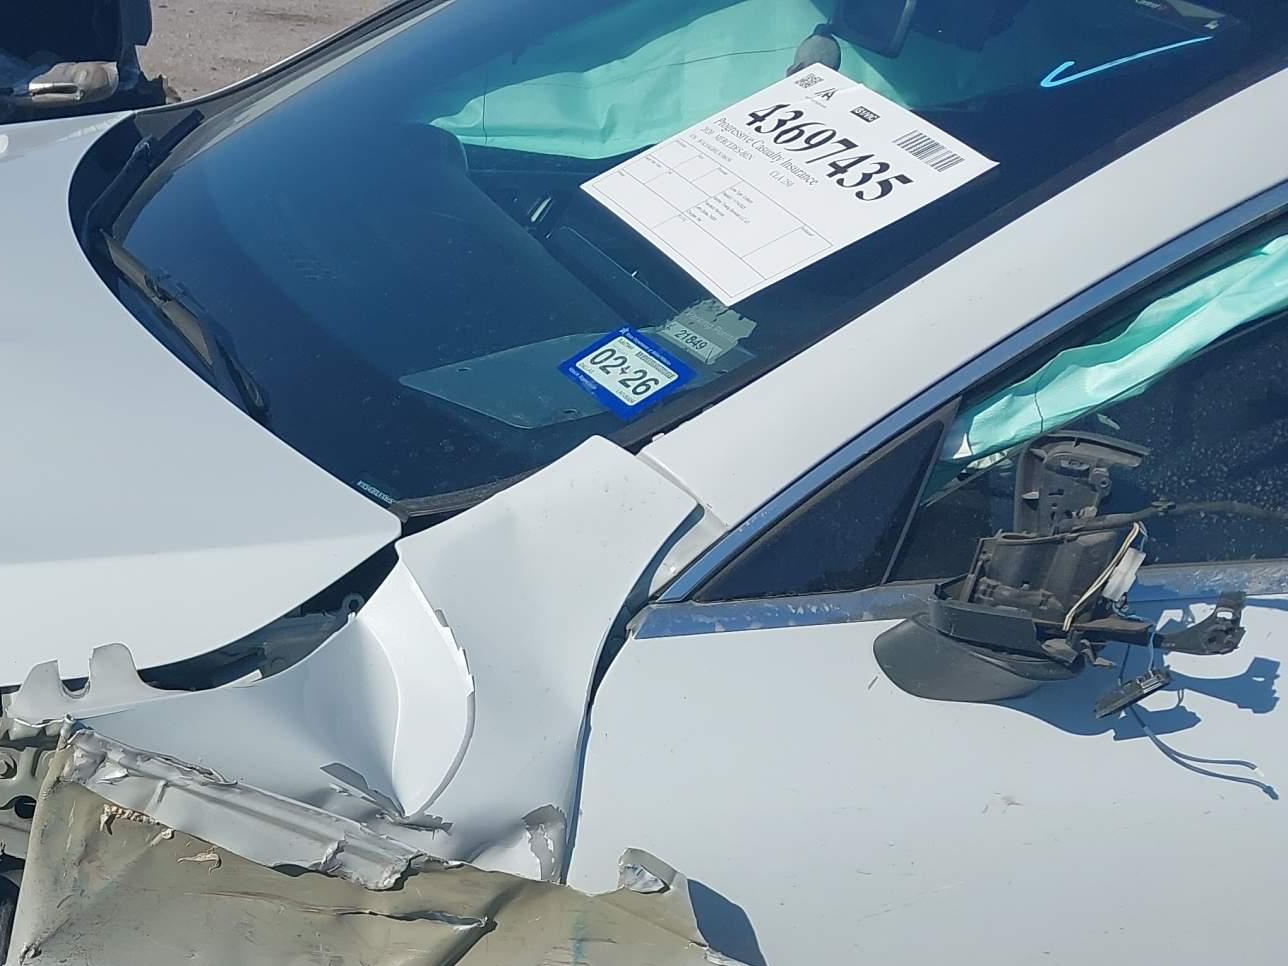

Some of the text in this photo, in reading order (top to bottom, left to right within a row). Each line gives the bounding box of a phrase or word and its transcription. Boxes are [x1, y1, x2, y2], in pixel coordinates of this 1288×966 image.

[713, 117, 753, 143] Progressive
[752, 140, 784, 163] Casualty
[780, 158, 818, 186] Insurance
[746, 103, 914, 201] 43697435
[675, 330, 708, 350] 21849
